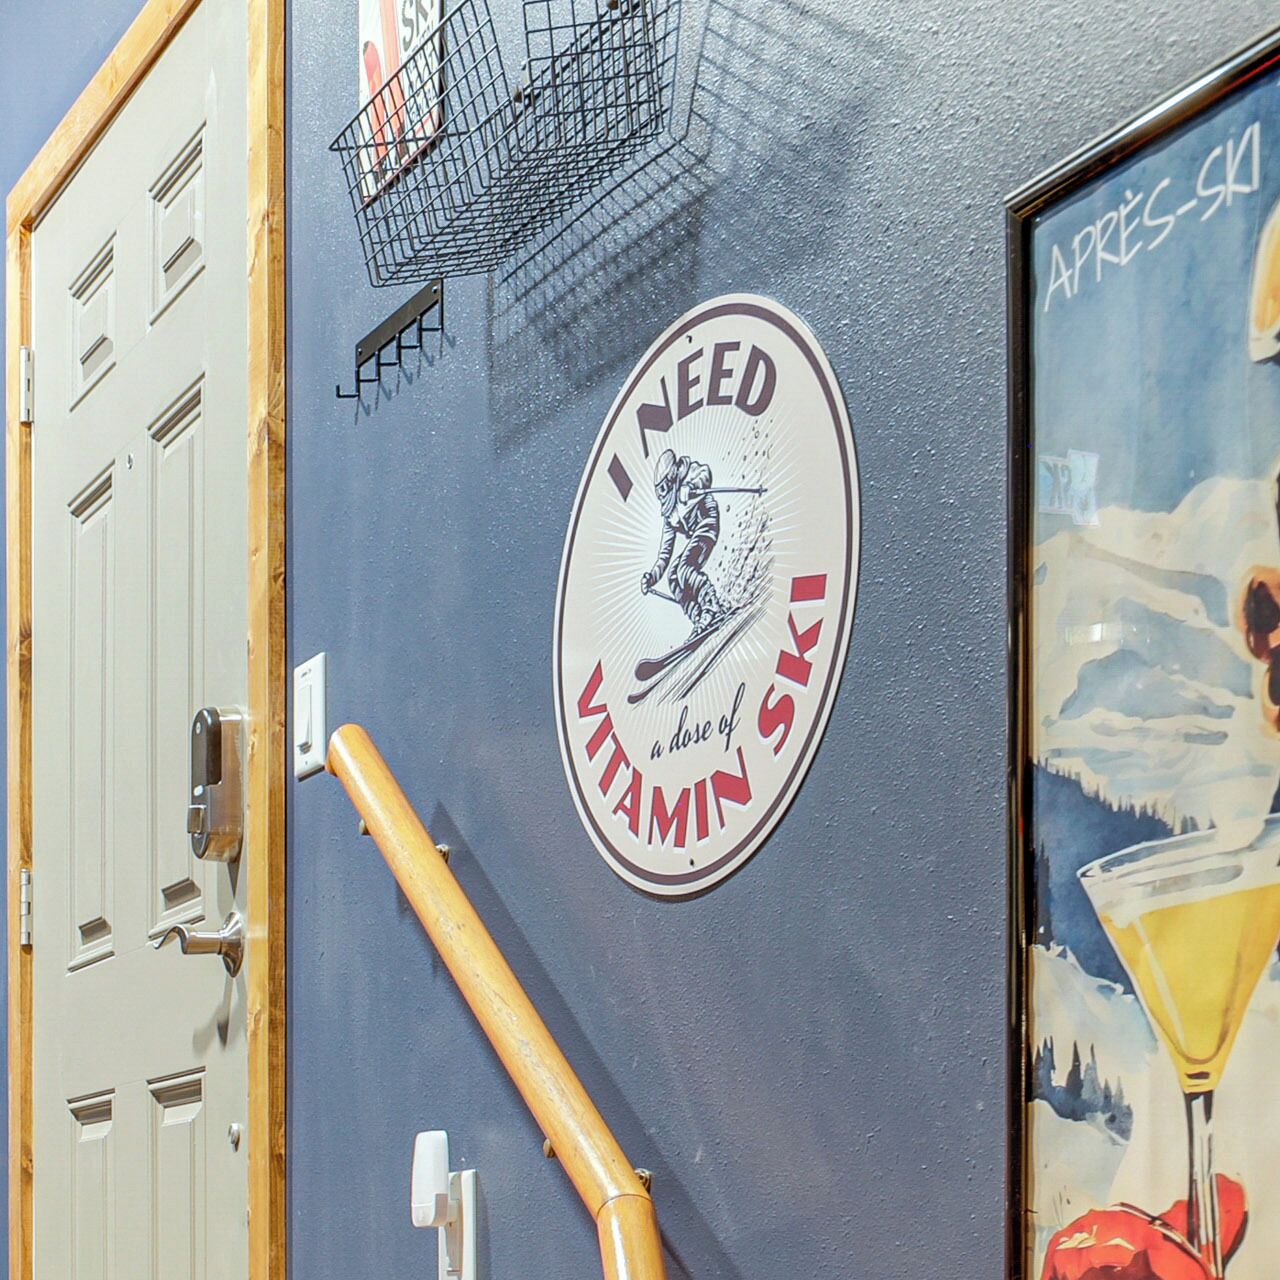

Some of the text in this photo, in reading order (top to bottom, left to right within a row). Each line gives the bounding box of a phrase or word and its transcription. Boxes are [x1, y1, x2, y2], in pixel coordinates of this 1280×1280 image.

[401, 0, 436, 52] SK
[607, 341, 777, 501] I NEED
[578, 573, 828, 849] VITAMIN SKI
[650, 683, 746, 760] a dose of
